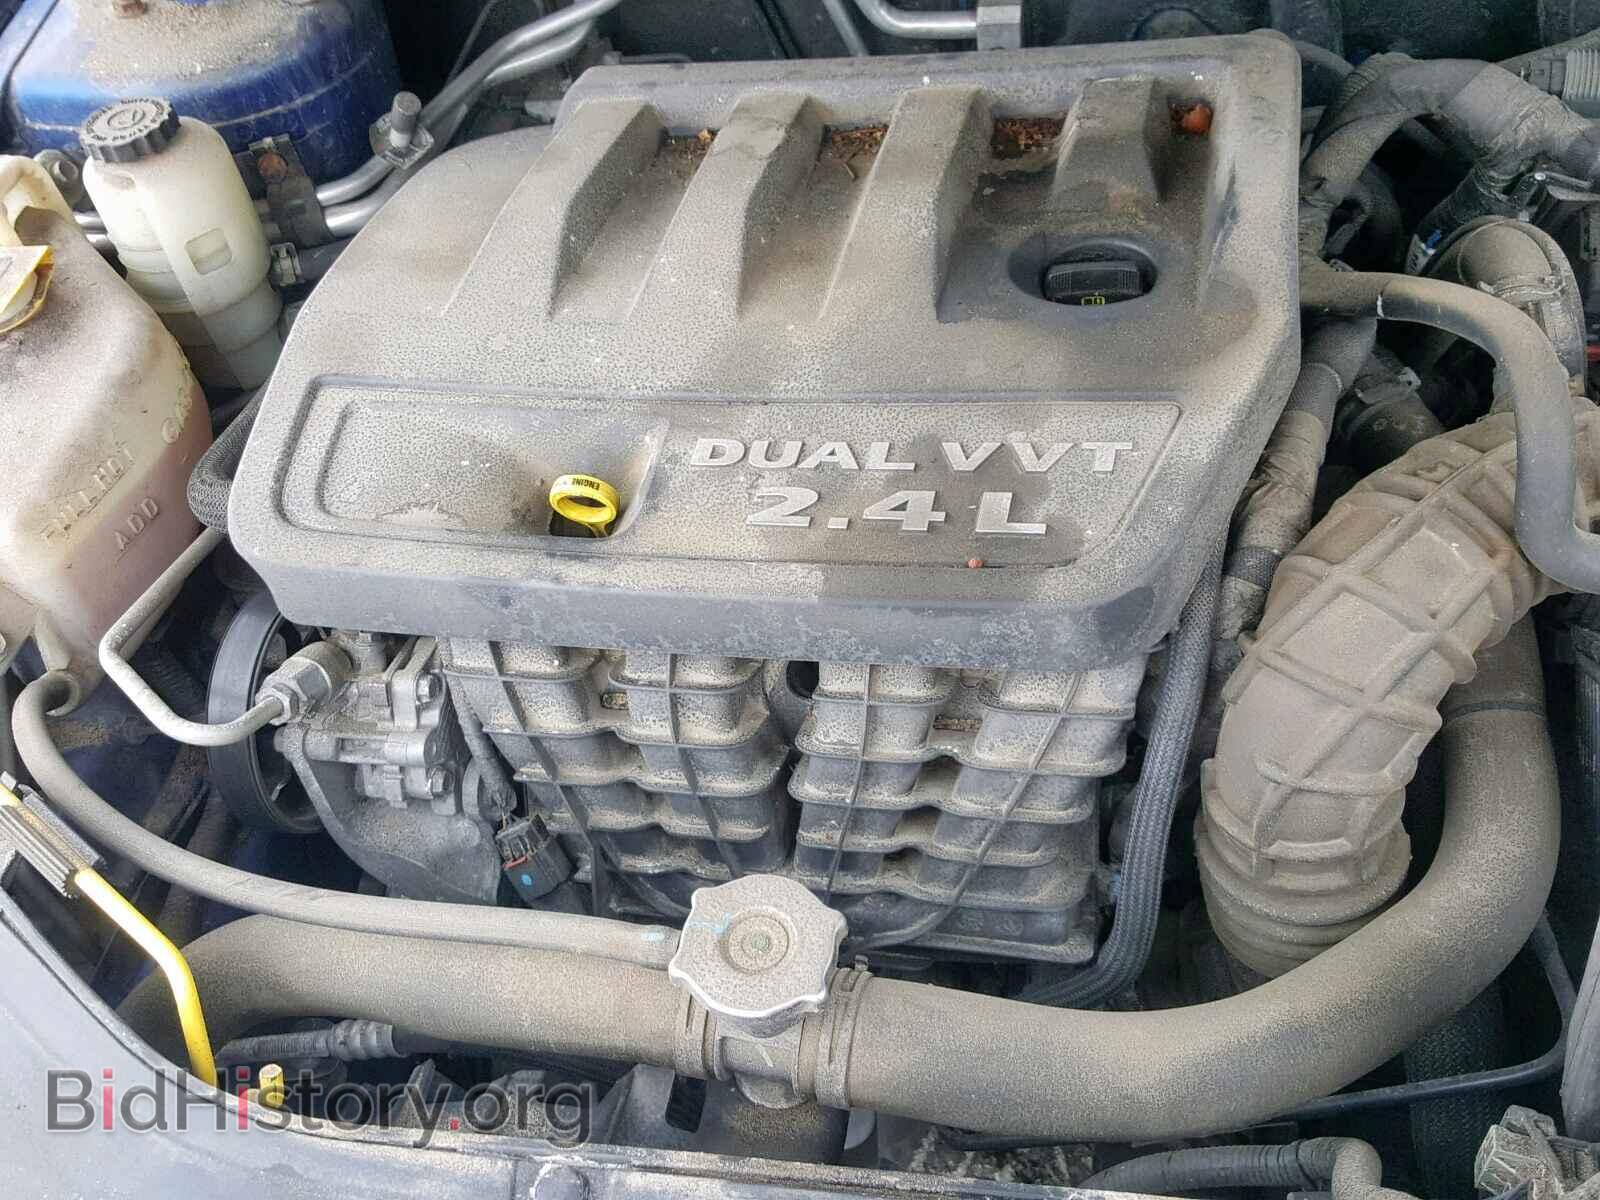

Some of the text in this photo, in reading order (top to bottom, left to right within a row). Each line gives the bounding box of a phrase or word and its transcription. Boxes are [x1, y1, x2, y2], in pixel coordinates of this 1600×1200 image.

[690, 438, 1134, 473] DUAL VVT
[113, 497, 160, 551] ADD
